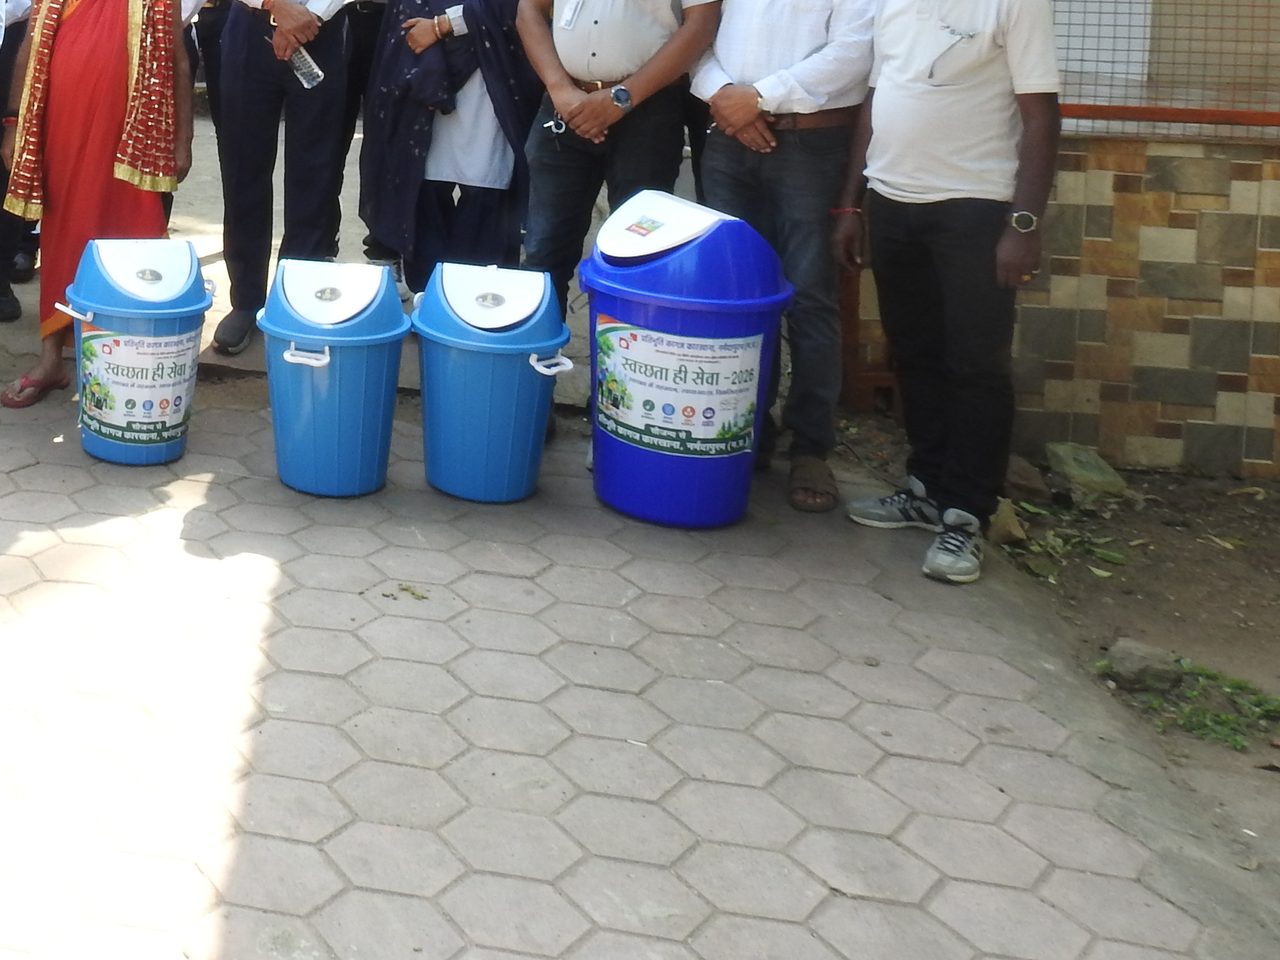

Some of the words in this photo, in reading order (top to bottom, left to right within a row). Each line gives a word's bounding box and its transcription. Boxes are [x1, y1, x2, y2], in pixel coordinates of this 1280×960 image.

[104, 361, 149, 380] स्वच्छता
[151, 362, 164, 381] ही
[167, 361, 186, 379] सेवा
[621, 356, 668, 382] स्वच्छता
[672, 364, 688, 385] ही
[691, 366, 720, 386] सेवा
